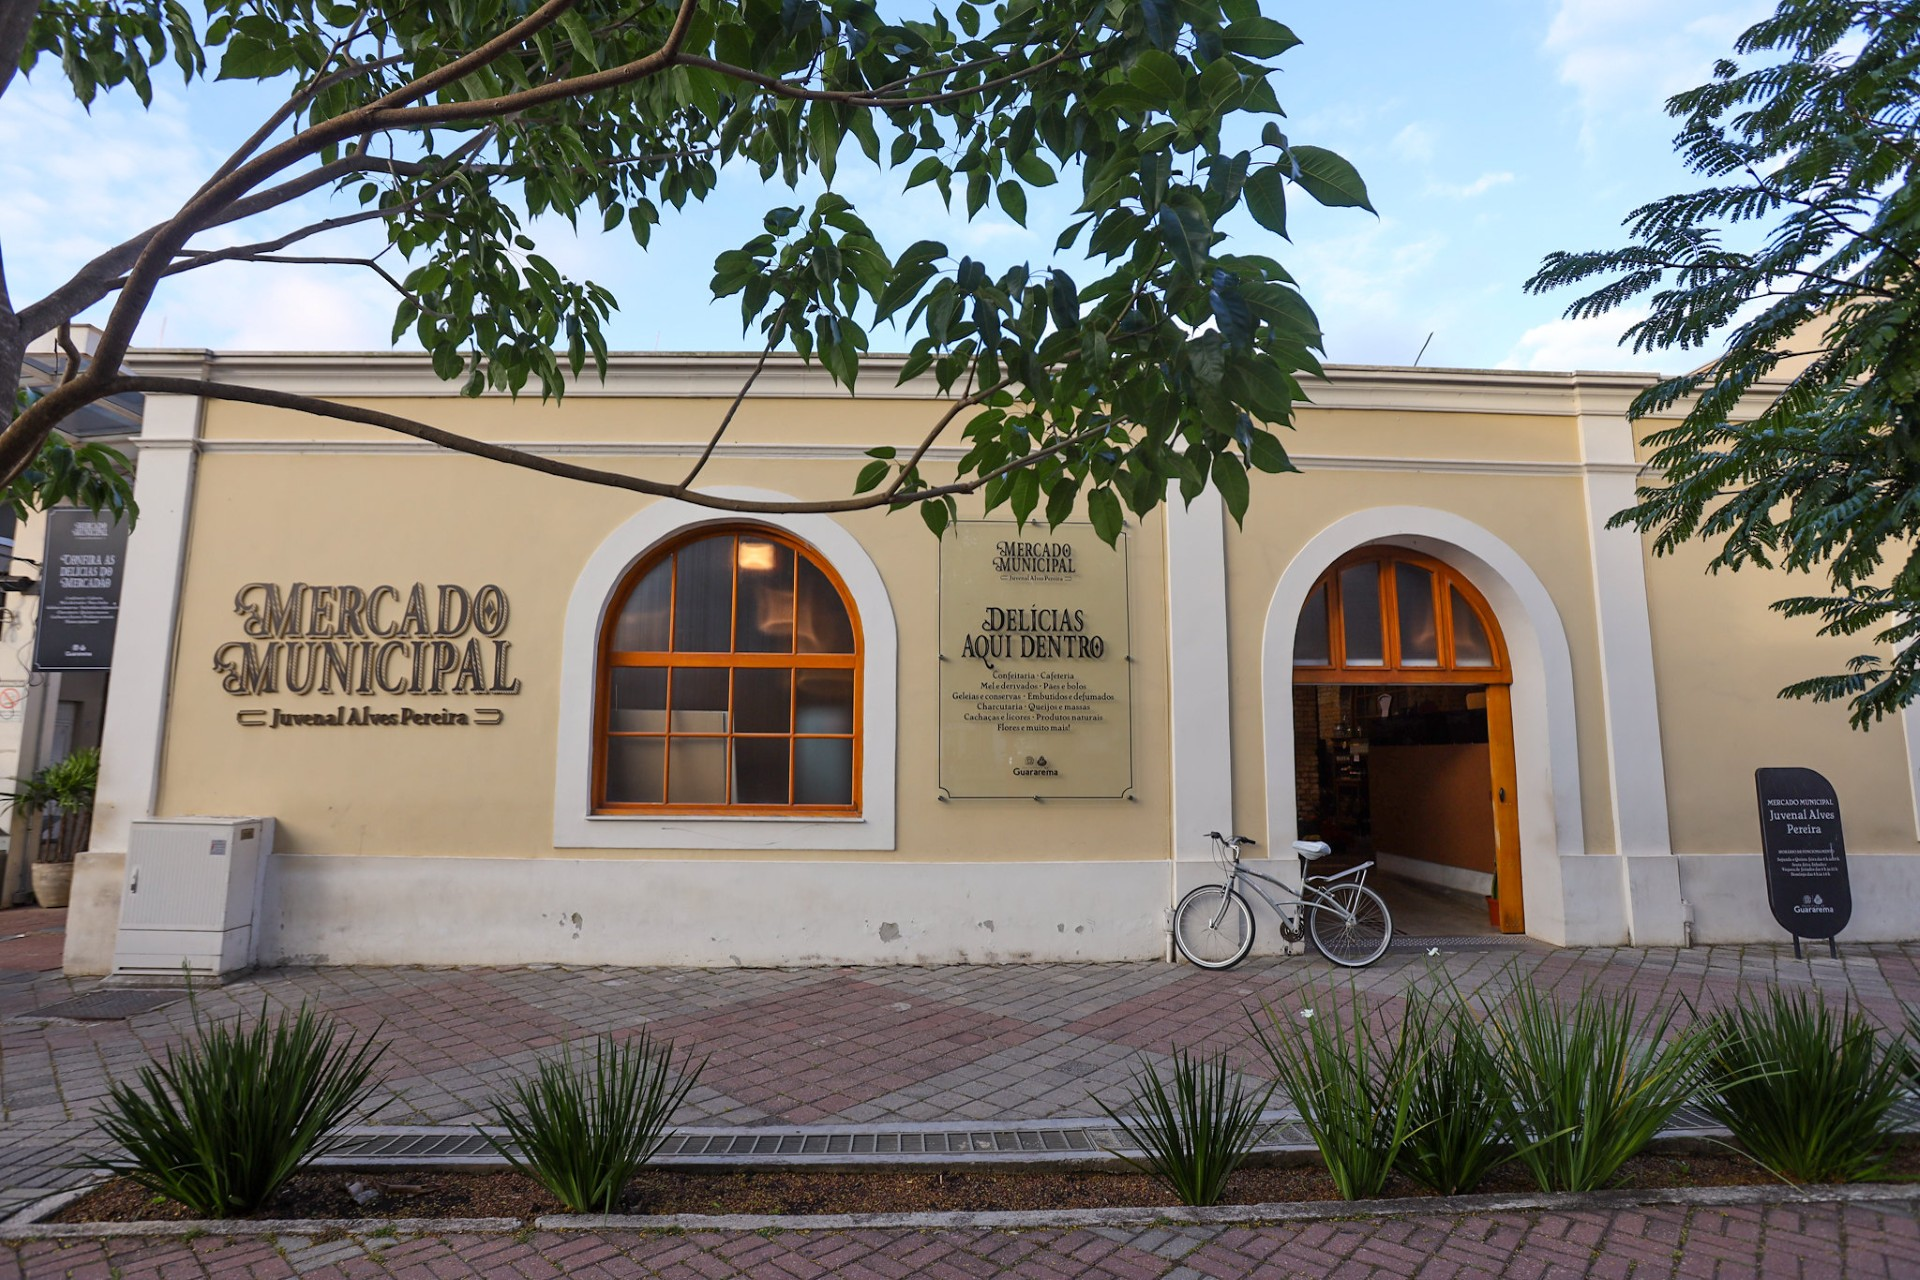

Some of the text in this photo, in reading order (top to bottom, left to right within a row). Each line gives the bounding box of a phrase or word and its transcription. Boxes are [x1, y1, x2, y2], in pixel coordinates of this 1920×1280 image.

[995, 541, 1072, 558] MERCADO
[103, 554, 116, 566] AS
[992, 557, 1076, 573] MUNICIPAL
[233, 581, 511, 640] MERCADO
[981, 604, 1084, 632] DELÍCIAS
[961, 633, 1105, 669] AQUI DENTRO
[212, 637, 522, 696] MUNICIPAL
[992, 671, 1075, 681] Confeitaria Cafeteria
[980, 682, 995, 690] Mel
[1000, 682, 1038, 690] derivados
[1066, 682, 1087, 690] bolos
[952, 692, 980, 700] Geleias
[1027, 692, 1068, 701] Embutidos
[1073, 692, 1114, 702] defumados
[976, 703, 1023, 711] Charcutaria
[1028, 703, 1058, 712] Queijos
[269, 705, 470, 730] Juvenal Alves Pereira
[963, 713, 1000, 722] Cachaças
[1006, 713, 1031, 721] licores
[1036, 713, 1071, 721] Produtos
[997, 723, 1020, 731] Flores
[1026, 723, 1050, 731] muito
[1050, 723, 1071, 731] mais!
[1012, 767, 1058, 776] Guararema
[1769, 808, 1835, 822] Juvenal Alves
[1786, 823, 1822, 835] Pereira
[1793, 905, 1834, 914] Guararema
